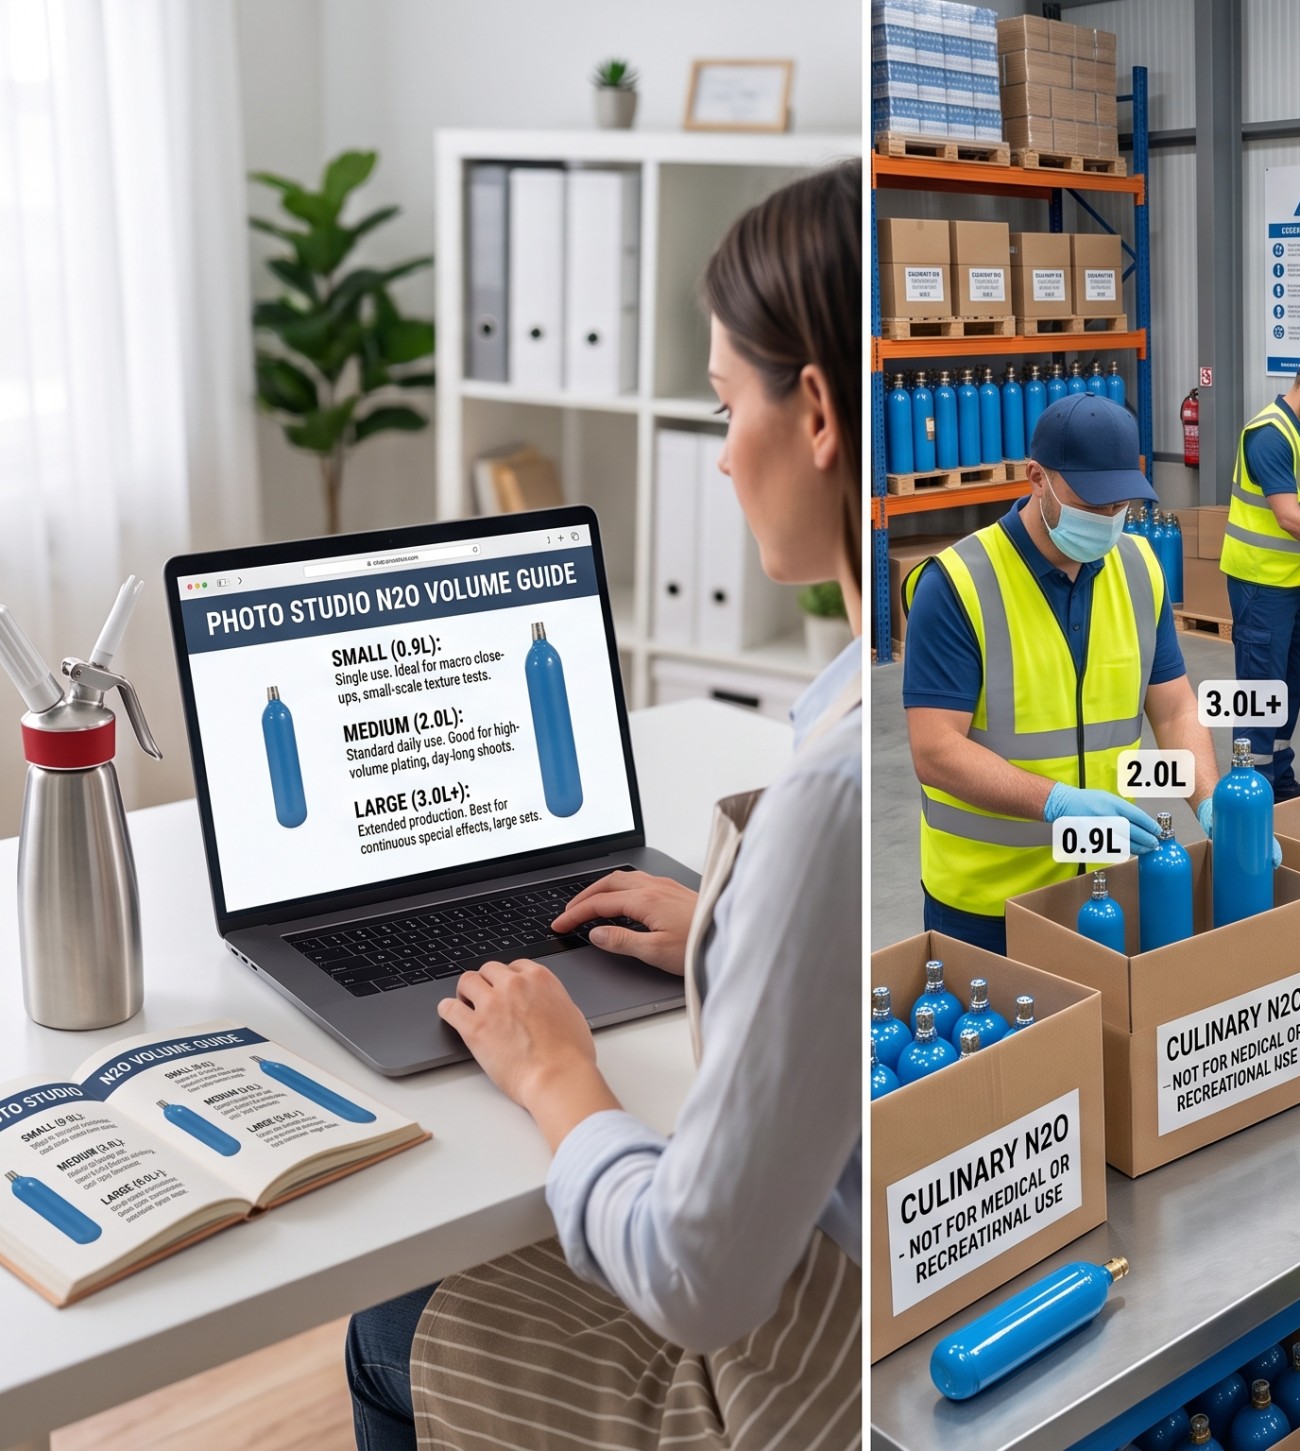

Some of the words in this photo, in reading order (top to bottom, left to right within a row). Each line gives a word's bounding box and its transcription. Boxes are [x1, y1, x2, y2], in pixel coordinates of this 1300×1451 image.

[206, 602, 284, 636] PHOTO
[290, 590, 371, 624] STUDIO
[375, 584, 420, 612] N2O
[423, 570, 512, 604] VOLUME
[516, 561, 578, 591] GUIDE
[331, 643, 388, 668] SMALL
[391, 634, 442, 662] (0.9L):
[334, 669, 368, 687] Single
[370, 667, 393, 681] use.
[394, 660, 420, 677] Ideal
[421, 659, 437, 674] for
[439, 656, 472, 670] macro
[473, 650, 505, 665] close-
[337, 691, 361, 707] ups,
[423, 673, 461, 691] texture
[462, 670, 492, 684] tests.
[343, 715, 410, 743] MEDIUM
[413, 706, 464, 735] (2.0L):
[346, 740, 395, 761] Standard
[396, 737, 421, 753] daily
[423, 735, 446, 748] use.
[447, 727, 475, 744] Good
[477, 725, 492, 740] for
[493, 720, 520, 738] high-
[349, 762, 389, 779] volume
[391, 754, 430, 775] plating,
[431, 747, 475, 766] day-long
[477, 740, 515, 757] shoots.
[354, 792, 408, 819] LARGE
[411, 781, 471, 812] (3.0L+):
[357, 816, 407, 837] Extended
[409, 807, 468, 831] production.
[469, 801, 492, 816] Best
[493, 798, 509, 812] for
[360, 835, 417, 855] continuous
[418, 824, 454, 846] special
[455, 820, 492, 837] effects,
[492, 814, 518, 830] large
[519, 810, 542, 824] sets.
[1166, 1002, 1262, 1062] CULINARY
[23, 1086, 84, 1107] STUDIO
[99, 1061, 132, 1086] N2O
[1177, 1059, 1271, 1112] RECREATIONAL
[1202, 1054, 1228, 1078] FOR
[21, 1122, 57, 1143] SMALL
[901, 1137, 1019, 1224] CULINARY
[1025, 1113, 1069, 1161] N2O
[100, 1183, 135, 1206] LARGE
[909, 1222, 942, 1259] NOT
[946, 1204, 977, 1238] FOR
[981, 1168, 1046, 1219] MEDICAL
[1050, 1153, 1070, 1180] OR
[1034, 1183, 1063, 1214] USE
